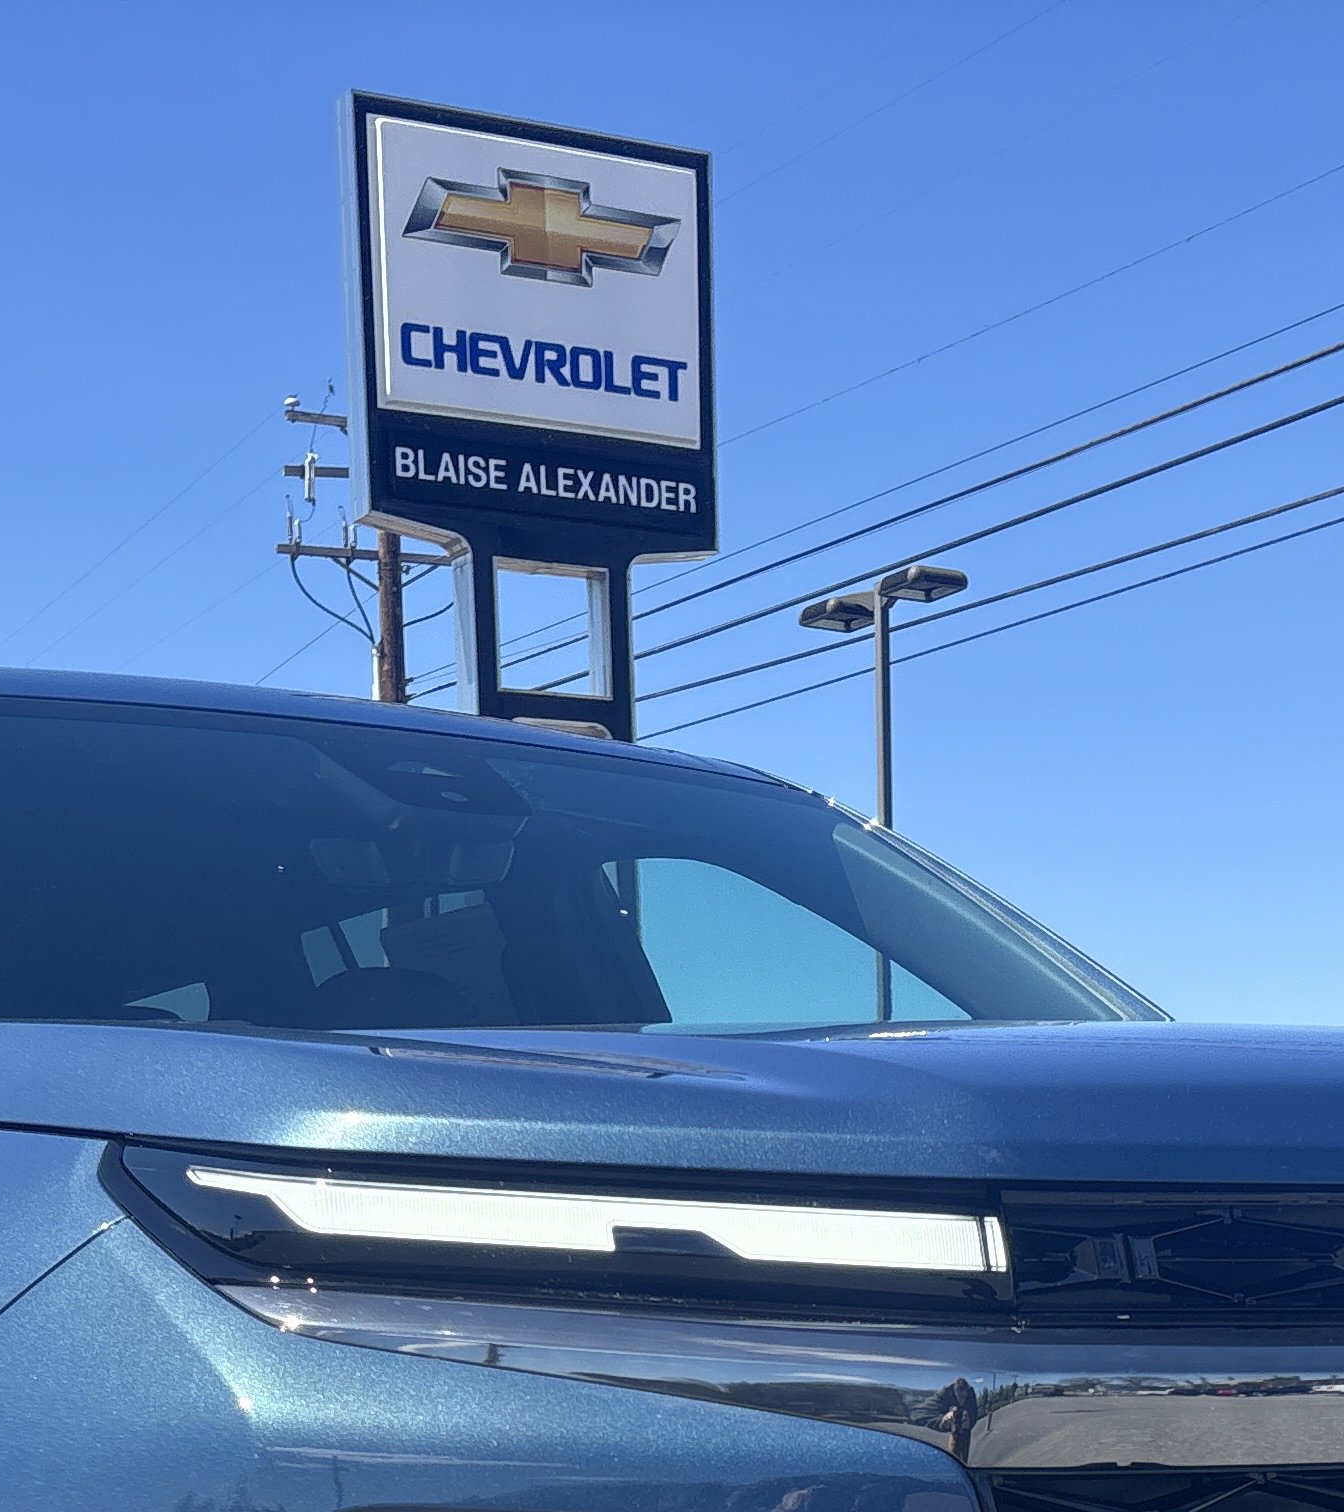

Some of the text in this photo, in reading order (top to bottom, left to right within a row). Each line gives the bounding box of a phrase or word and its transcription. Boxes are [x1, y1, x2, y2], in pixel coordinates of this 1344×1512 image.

[400, 321, 688, 402] CHEVROLET
[394, 444, 698, 514] BLAISE ALEXANDER
